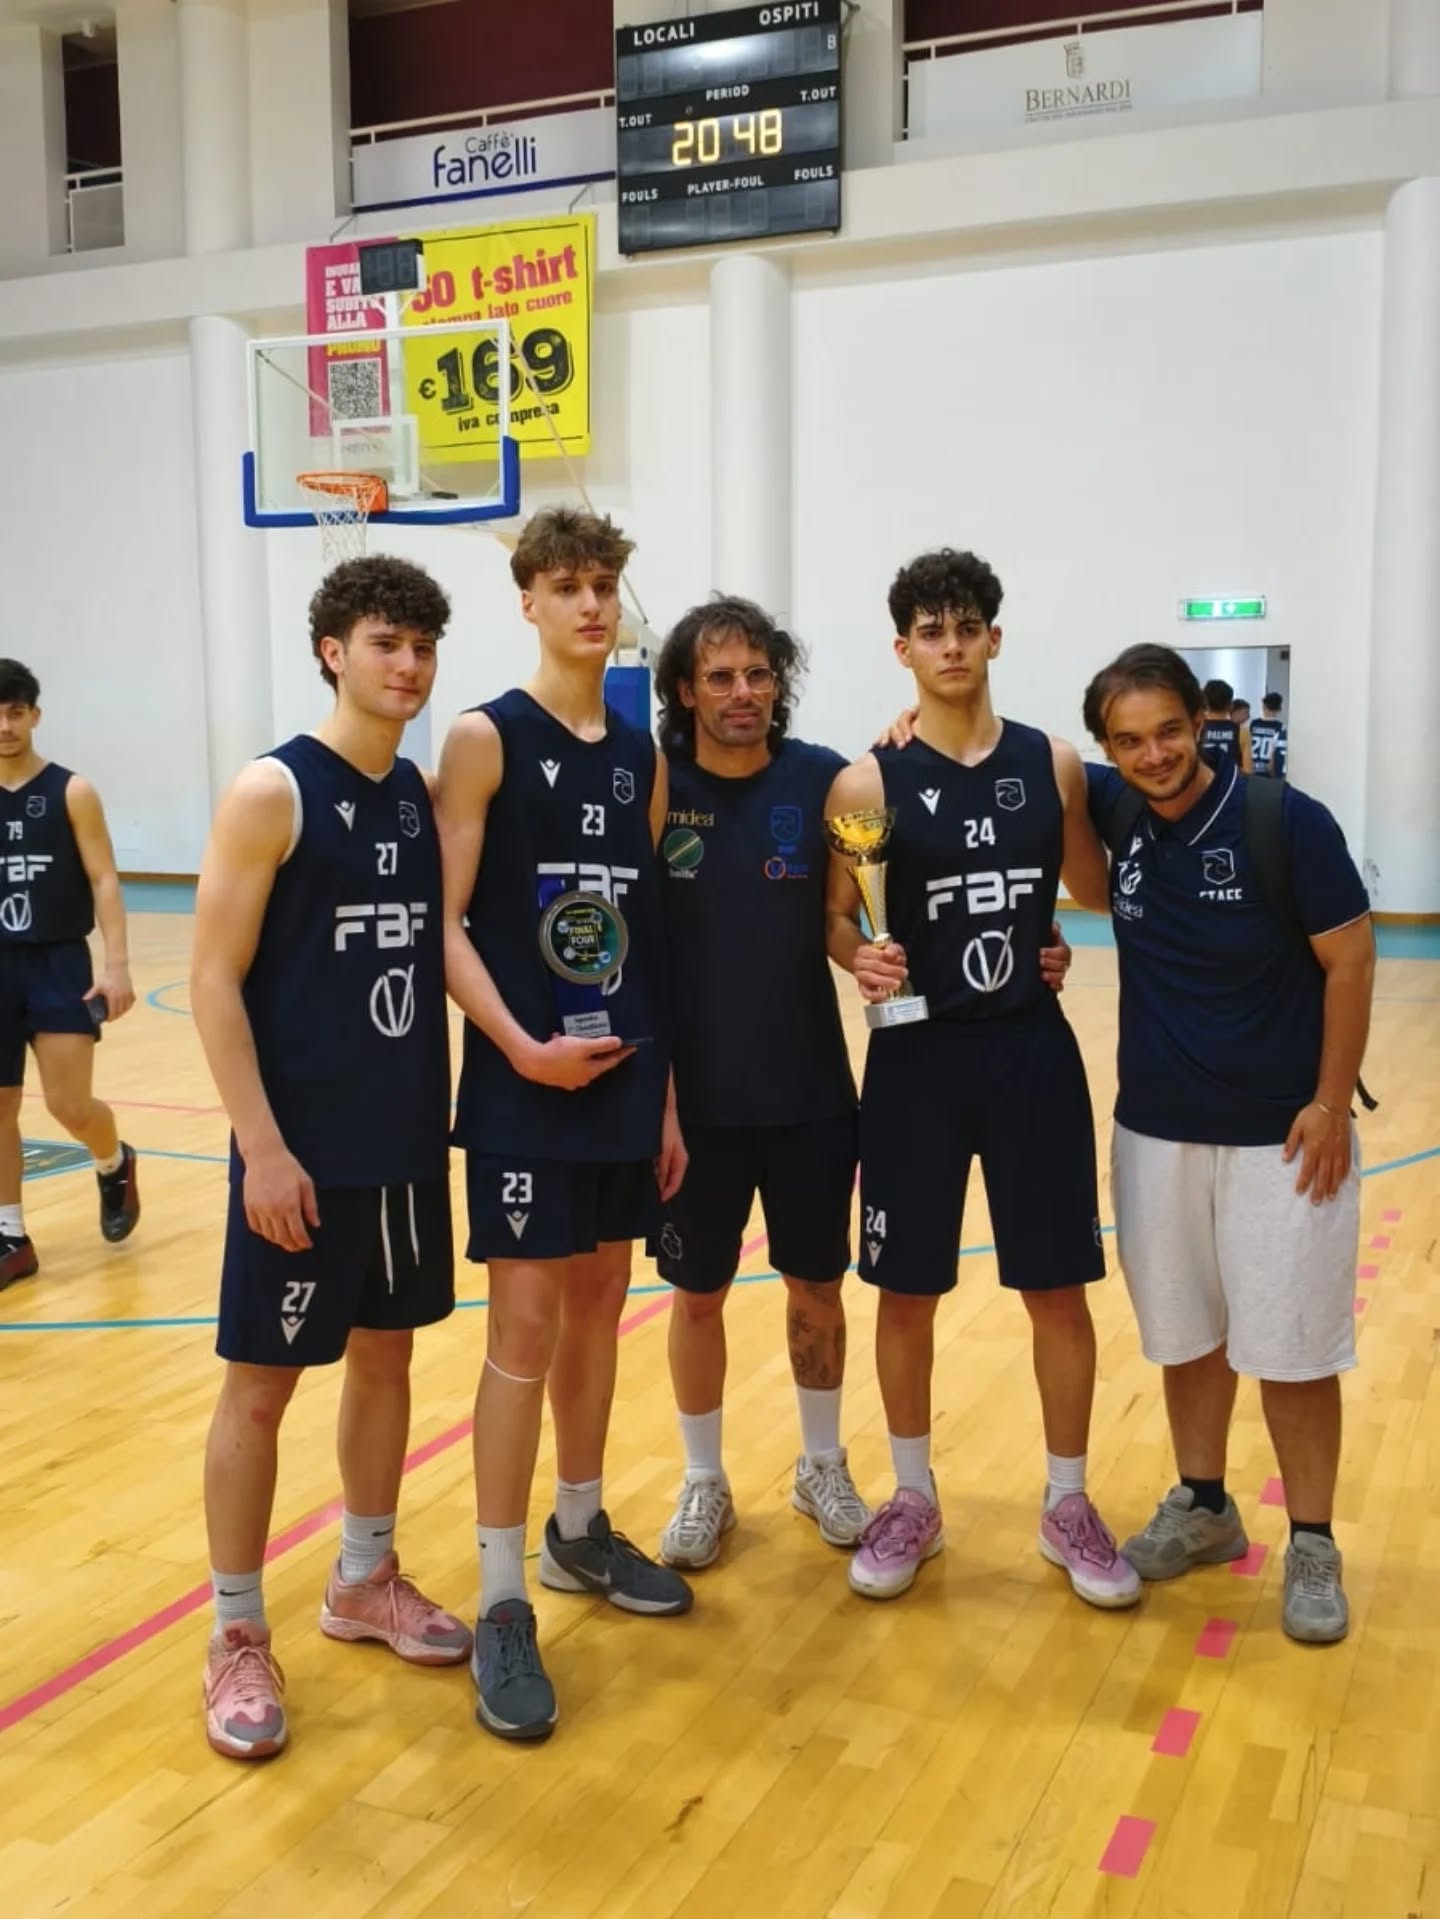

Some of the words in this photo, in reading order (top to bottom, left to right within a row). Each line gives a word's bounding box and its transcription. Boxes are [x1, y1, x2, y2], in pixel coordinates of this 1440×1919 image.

[759, 2, 819, 26] OSPITI
[633, 21, 695, 46] LOCALI
[706, 85, 750, 101] PERIOD
[800, 86, 837, 102] T.OUT
[1025, 79, 1131, 112] BERNARDI
[619, 114, 653, 129] T.OUT
[672, 118, 720, 166] 20
[733, 108, 782, 155] 48
[432, 136, 537, 189] fanelli
[794, 165, 833, 181] FOULS
[622, 188, 659, 204] FOULS
[687, 176, 765, 195] PLAYER-FOUL
[471, 244, 578, 300] t-shirt
[325, 280, 337, 297] E
[488, 300, 519, 320] lato
[526, 290, 573, 312] cuore
[327, 312, 368, 331] ALLA
[418, 378, 437, 400] €
[437, 328, 575, 416] 169
[458, 416, 480, 432] iva
[1251, 736, 1274, 759] 20
[582, 803, 605, 836] 23
[667, 808, 715, 827] midea
[963, 817, 996, 849] 24
[0, 855, 54, 882] BF
[375, 842, 398, 876] 27
[926, 867, 1043, 921] FBF
[334, 902, 428, 952] FBF
[502, 1172, 533, 1203] 23
[865, 1205, 887, 1239] 24
[281, 1281, 317, 1313] 27
